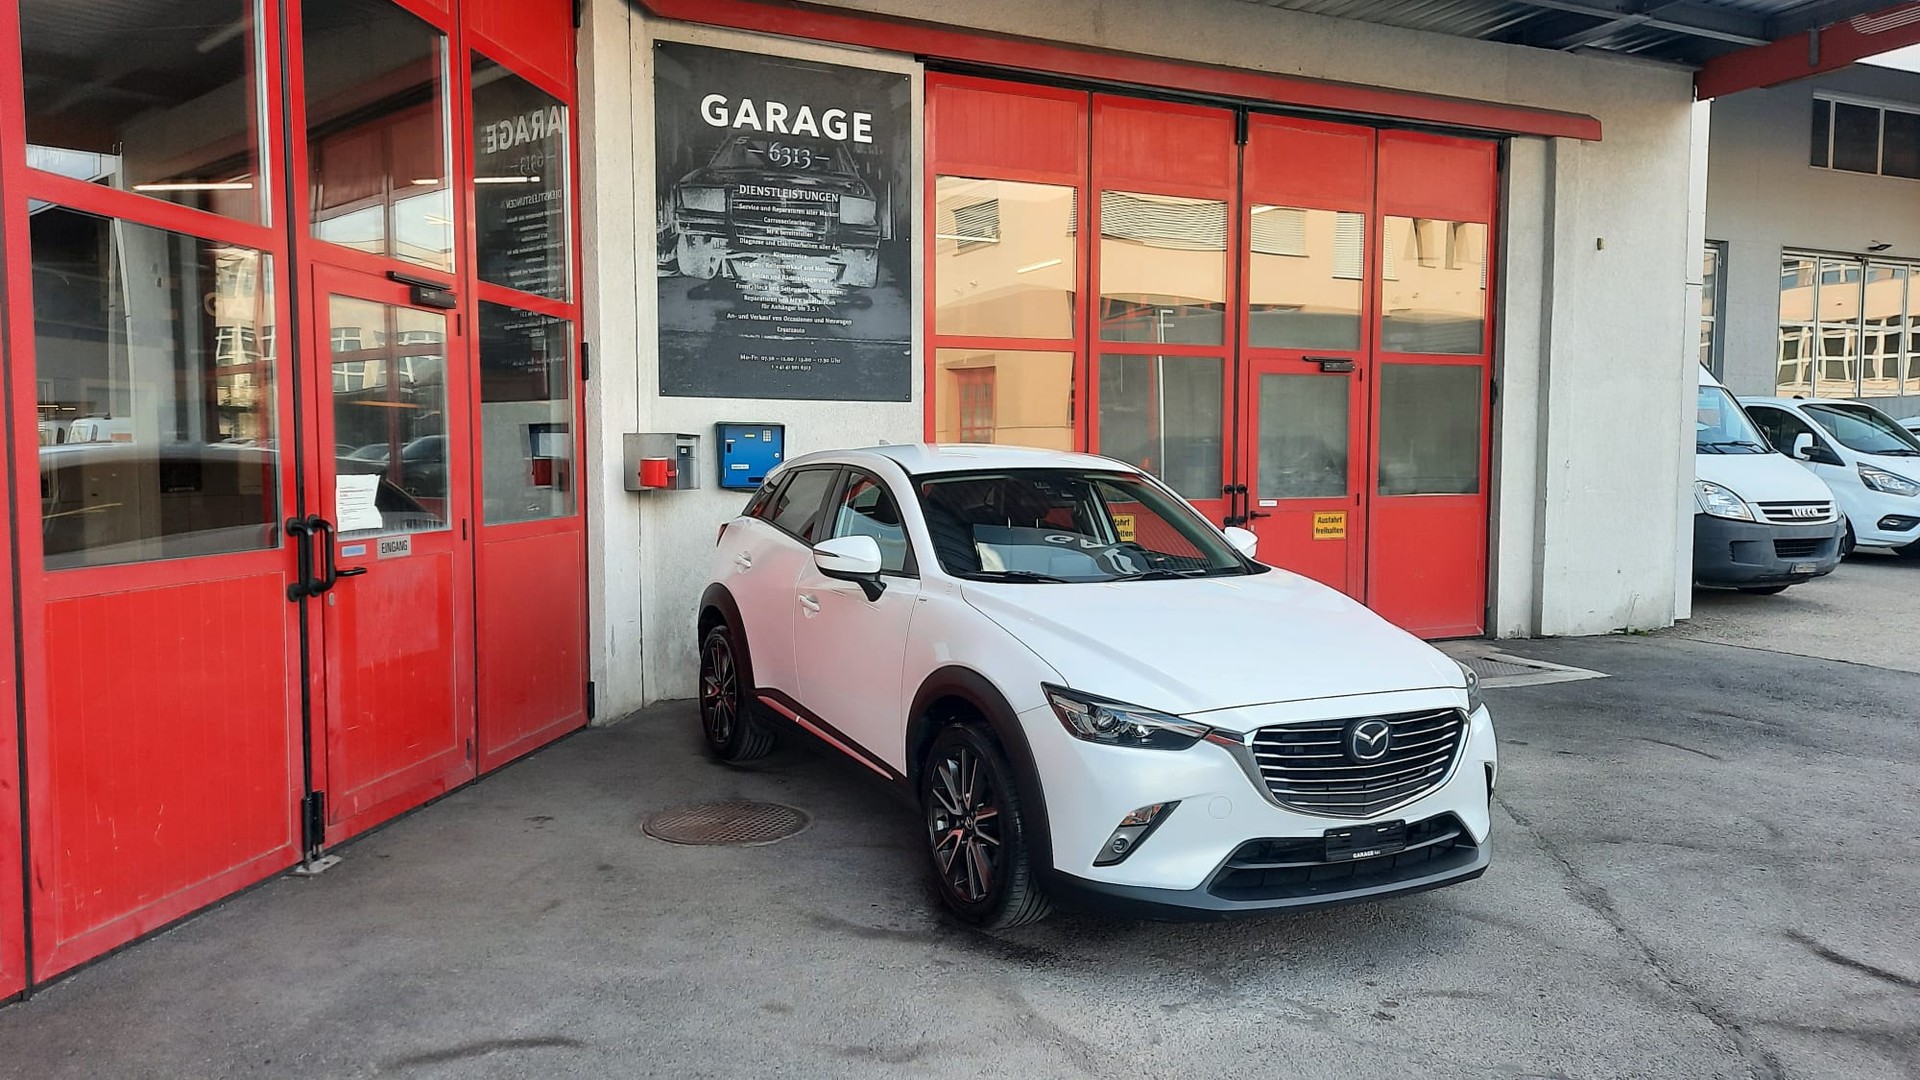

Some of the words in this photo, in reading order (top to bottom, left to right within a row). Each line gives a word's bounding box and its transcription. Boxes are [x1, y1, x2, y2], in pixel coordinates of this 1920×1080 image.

[700, 93, 873, 144] GARAGE
[768, 142, 812, 169] 6313
[739, 184, 839, 202] DIENSTLEISTUNGEN
[739, 203, 759, 211] Service
[739, 237, 764, 246] Diagnose
[773, 251, 807, 259] Klimaservice
[743, 294, 777, 303] Reparaturen
[771, 303, 797, 312] Anhänger
[749, 313, 772, 321] Verkauf
[783, 315, 813, 323] Occasionen
[825, 317, 853, 326] Neuwagen
[776, 326, 806, 334] Ersatzauto
[1791, 505, 1818, 518] IVECO
[1317, 516, 1343, 524] Ausfahrt
[1315, 527, 1344, 535] freihalten
[381, 540, 408, 554] EINGANG
[1352, 850, 1374, 859] GARAGE
